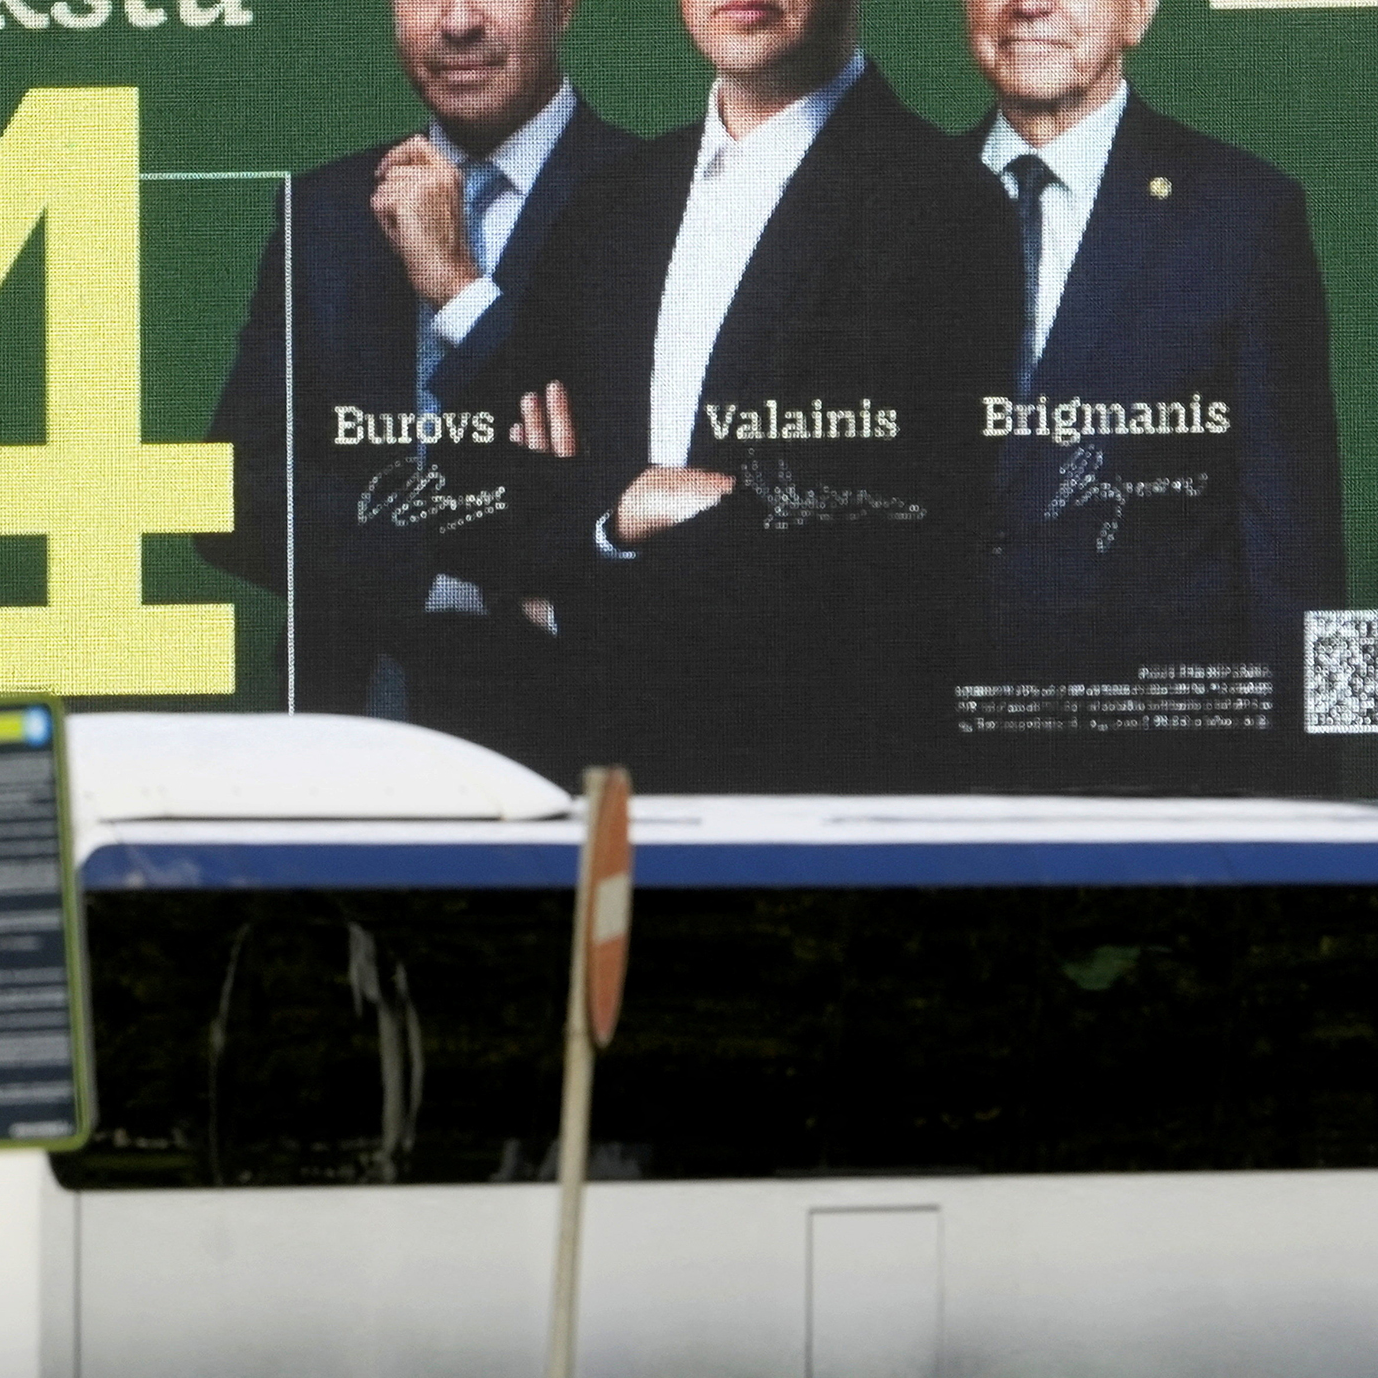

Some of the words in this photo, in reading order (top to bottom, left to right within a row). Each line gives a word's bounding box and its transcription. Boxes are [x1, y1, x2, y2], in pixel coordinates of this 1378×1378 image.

[334, 405, 495, 445] Burovs
[704, 399, 900, 440] Valainis
[982, 392, 1231, 446] Brigmanis
